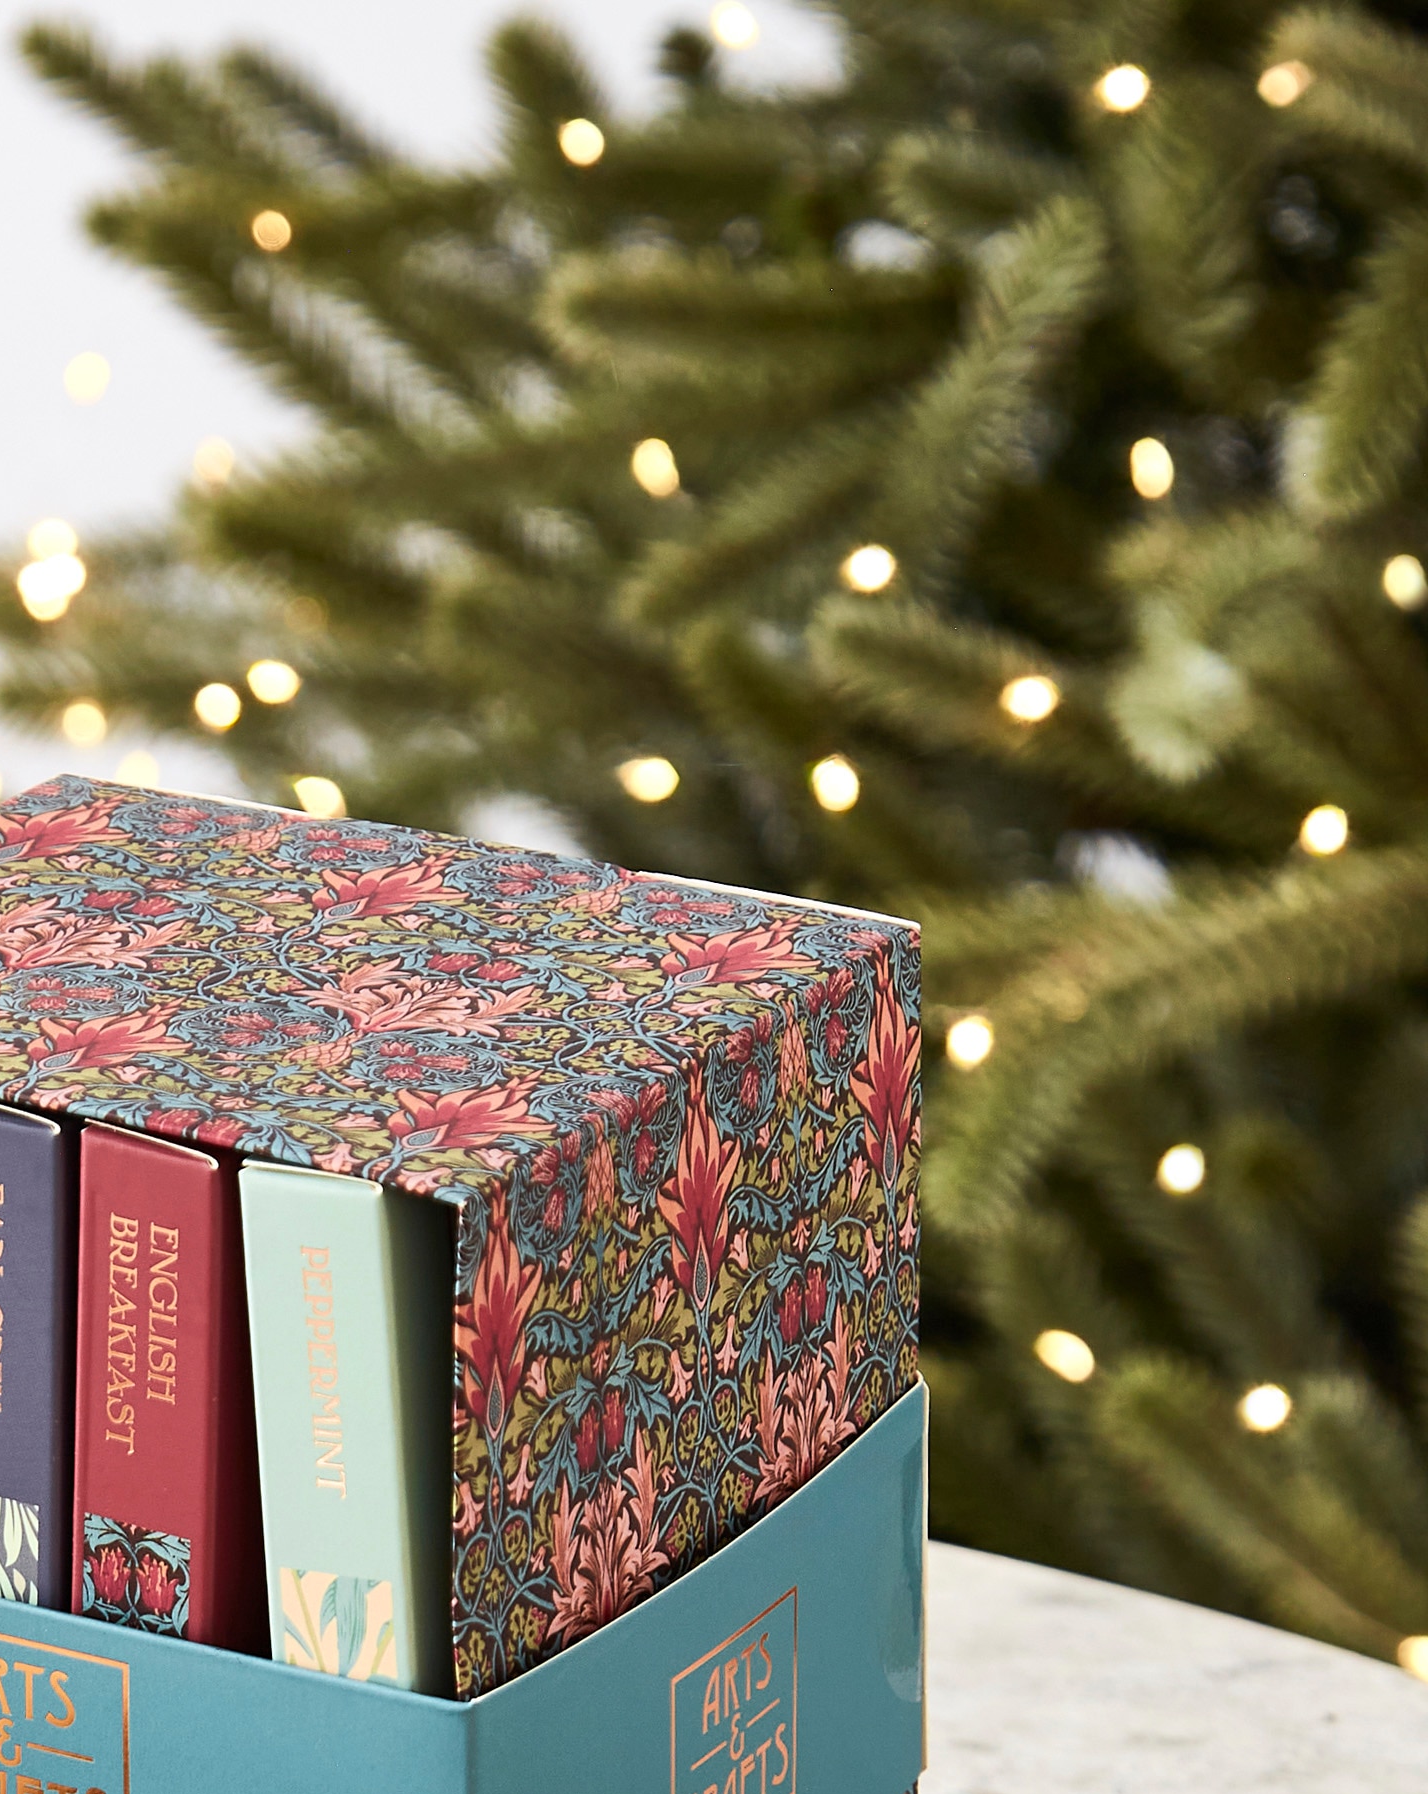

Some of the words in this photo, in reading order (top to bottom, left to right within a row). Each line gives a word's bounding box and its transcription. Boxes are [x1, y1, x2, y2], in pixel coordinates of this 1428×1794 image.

[105, 1211, 139, 1456] BREAKFAST
[146, 1221, 180, 1406] ENGLISH
[300, 1244, 347, 1501] PEPPERMINT
[702, 1632, 773, 1735] ARTS
[729, 1712, 745, 1762] &
